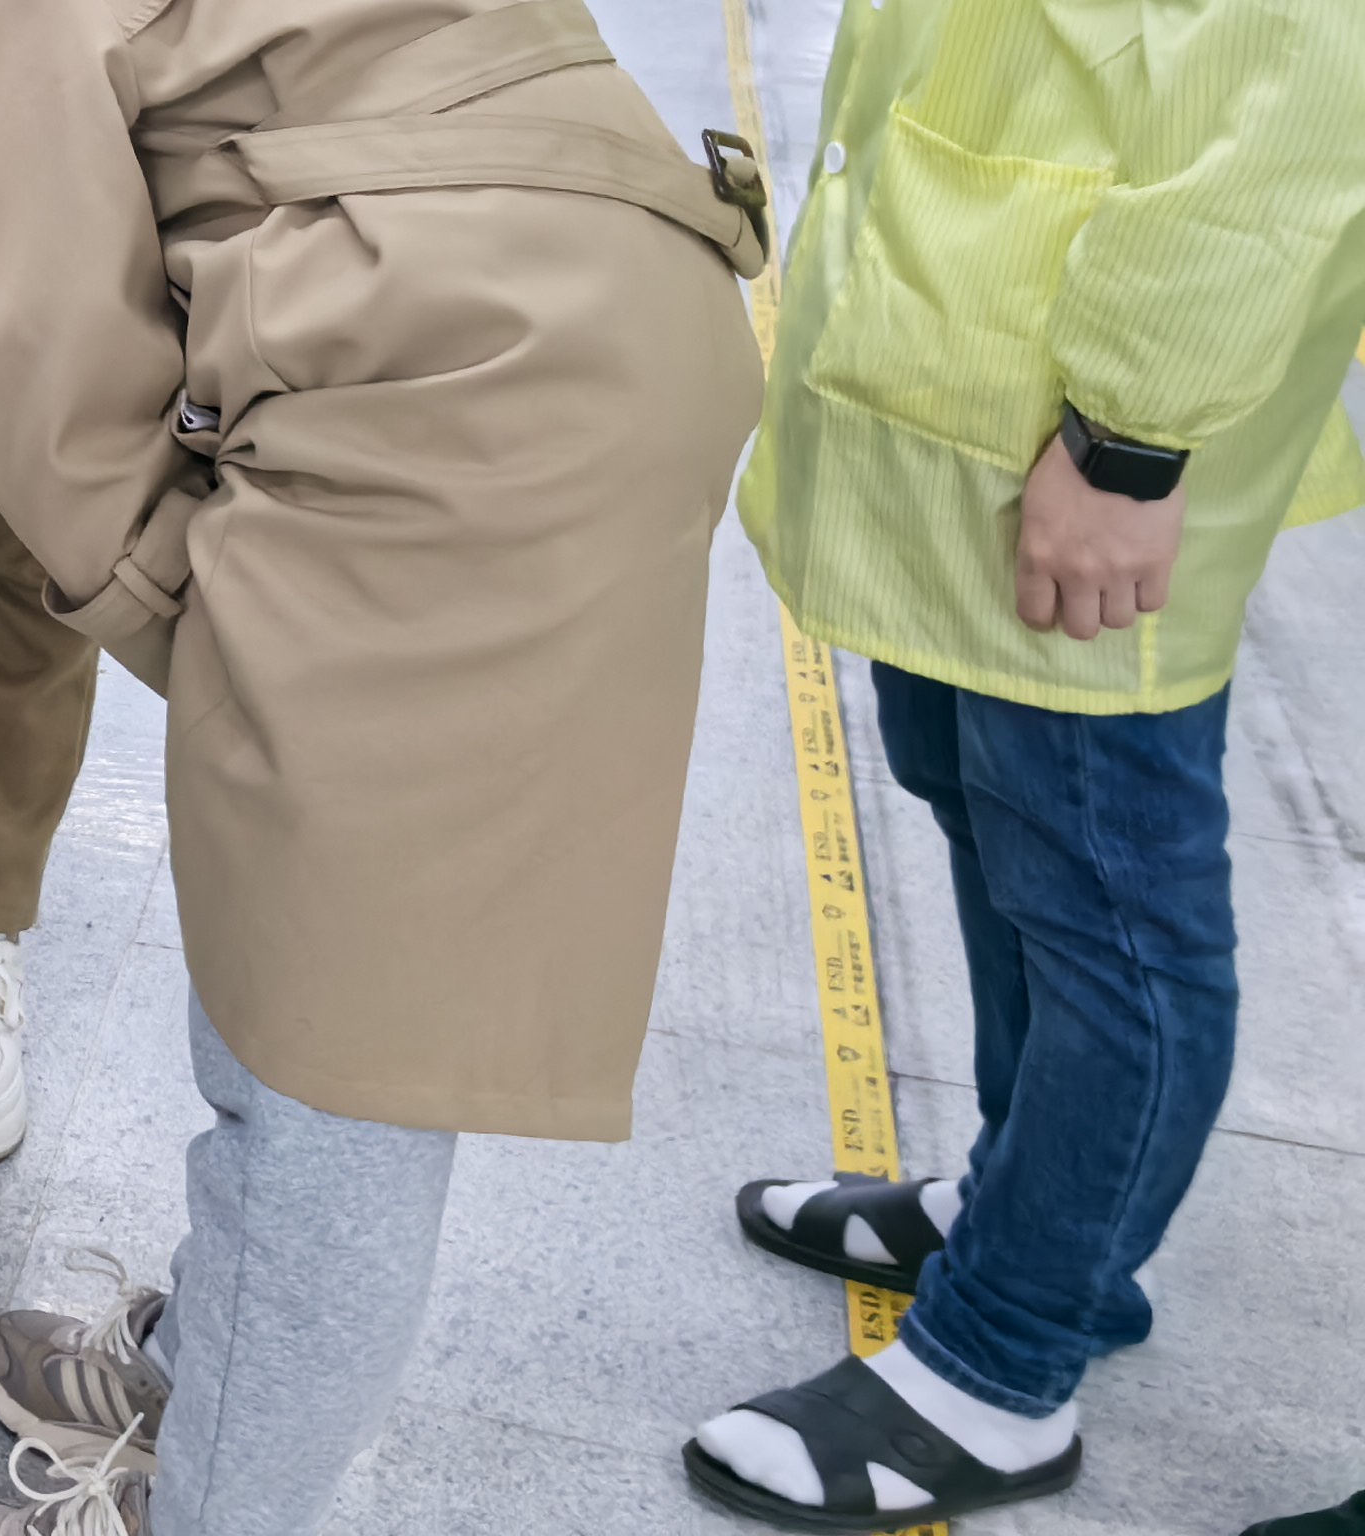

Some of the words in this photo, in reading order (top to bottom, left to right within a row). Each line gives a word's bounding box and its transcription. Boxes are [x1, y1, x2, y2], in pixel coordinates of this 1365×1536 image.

[825, 956, 846, 992] ESD
[840, 1107, 865, 1153] ESD
[859, 1290, 885, 1342] ESD
